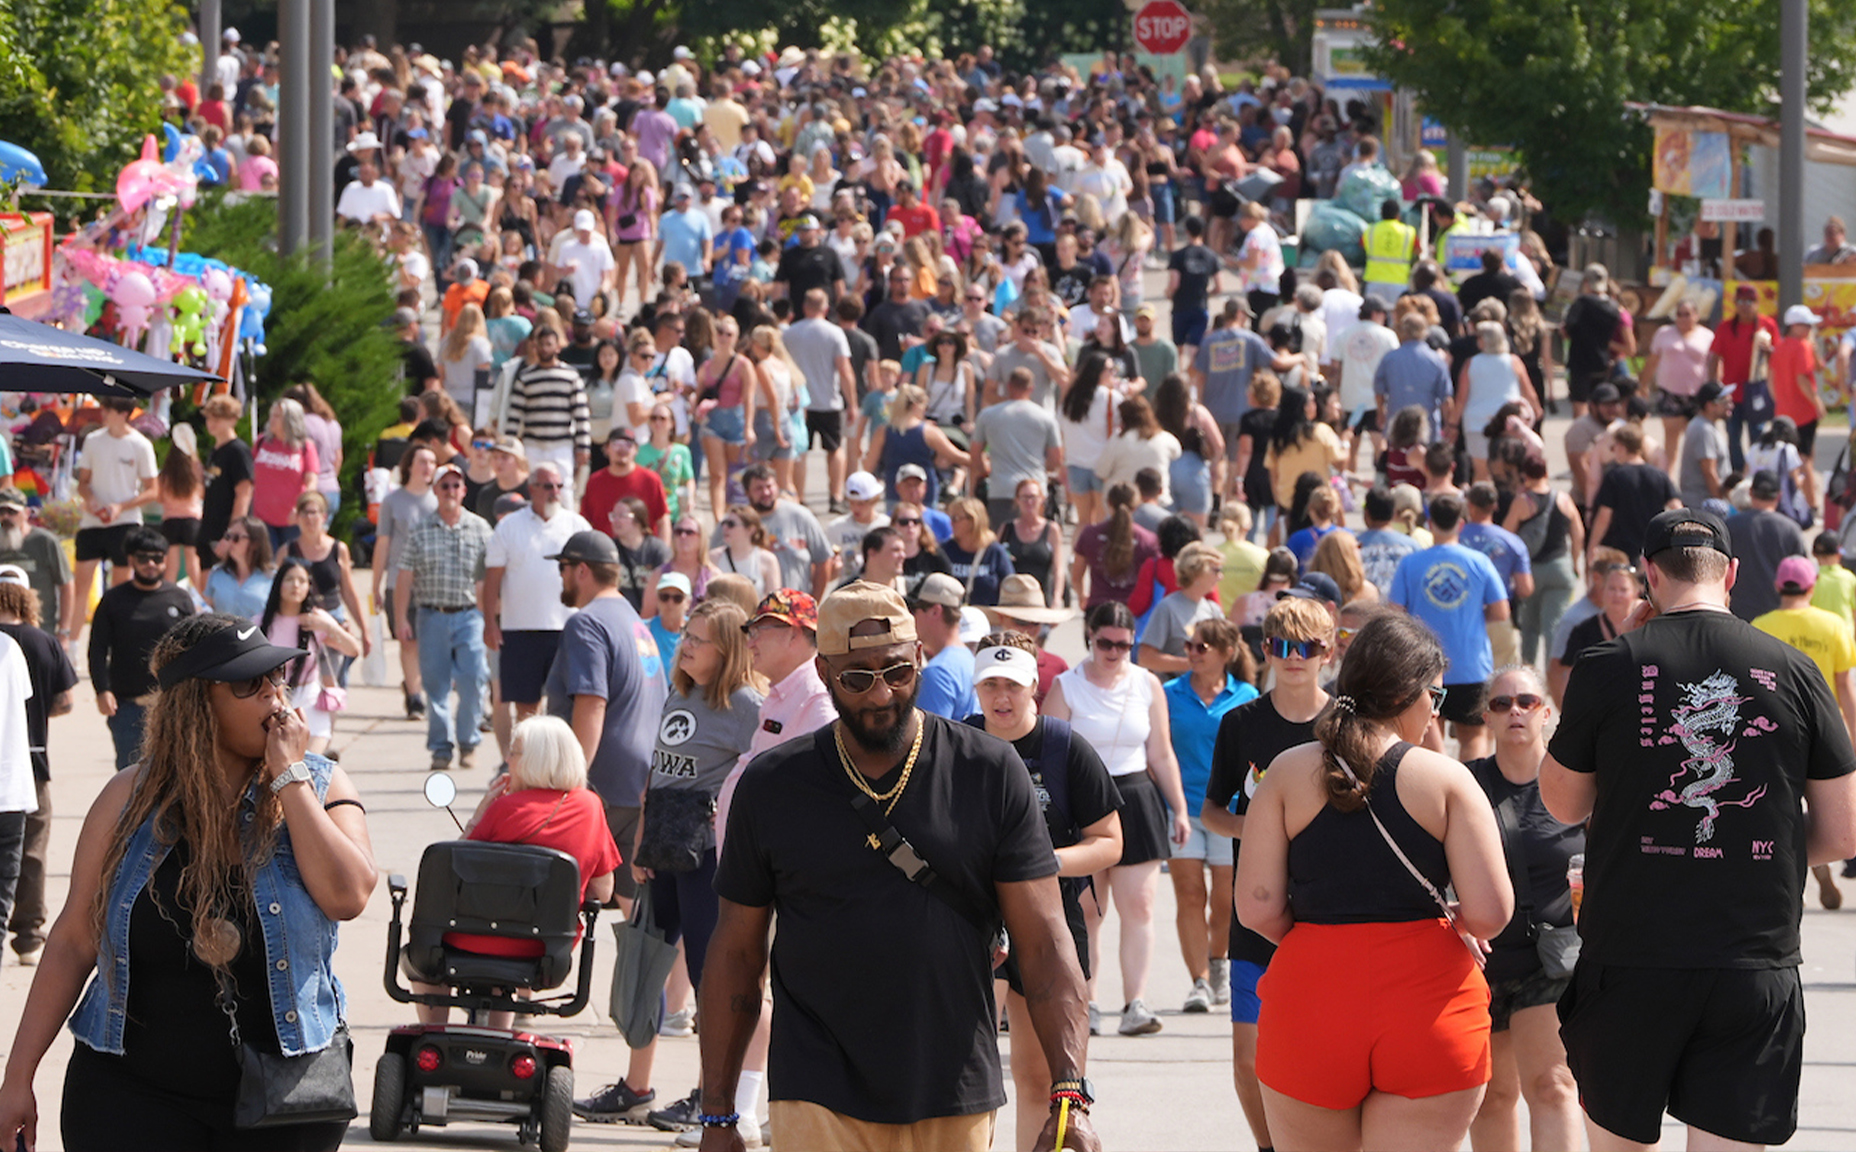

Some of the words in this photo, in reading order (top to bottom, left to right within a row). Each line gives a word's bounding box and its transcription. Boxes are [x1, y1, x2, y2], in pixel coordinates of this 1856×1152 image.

[1138, 16, 1187, 39] STOP
[650, 748, 699, 779] OWA
[1693, 846, 1724, 859] DREAM
[1751, 840, 1774, 853] NYC
[465, 1050, 488, 1059] Pride
